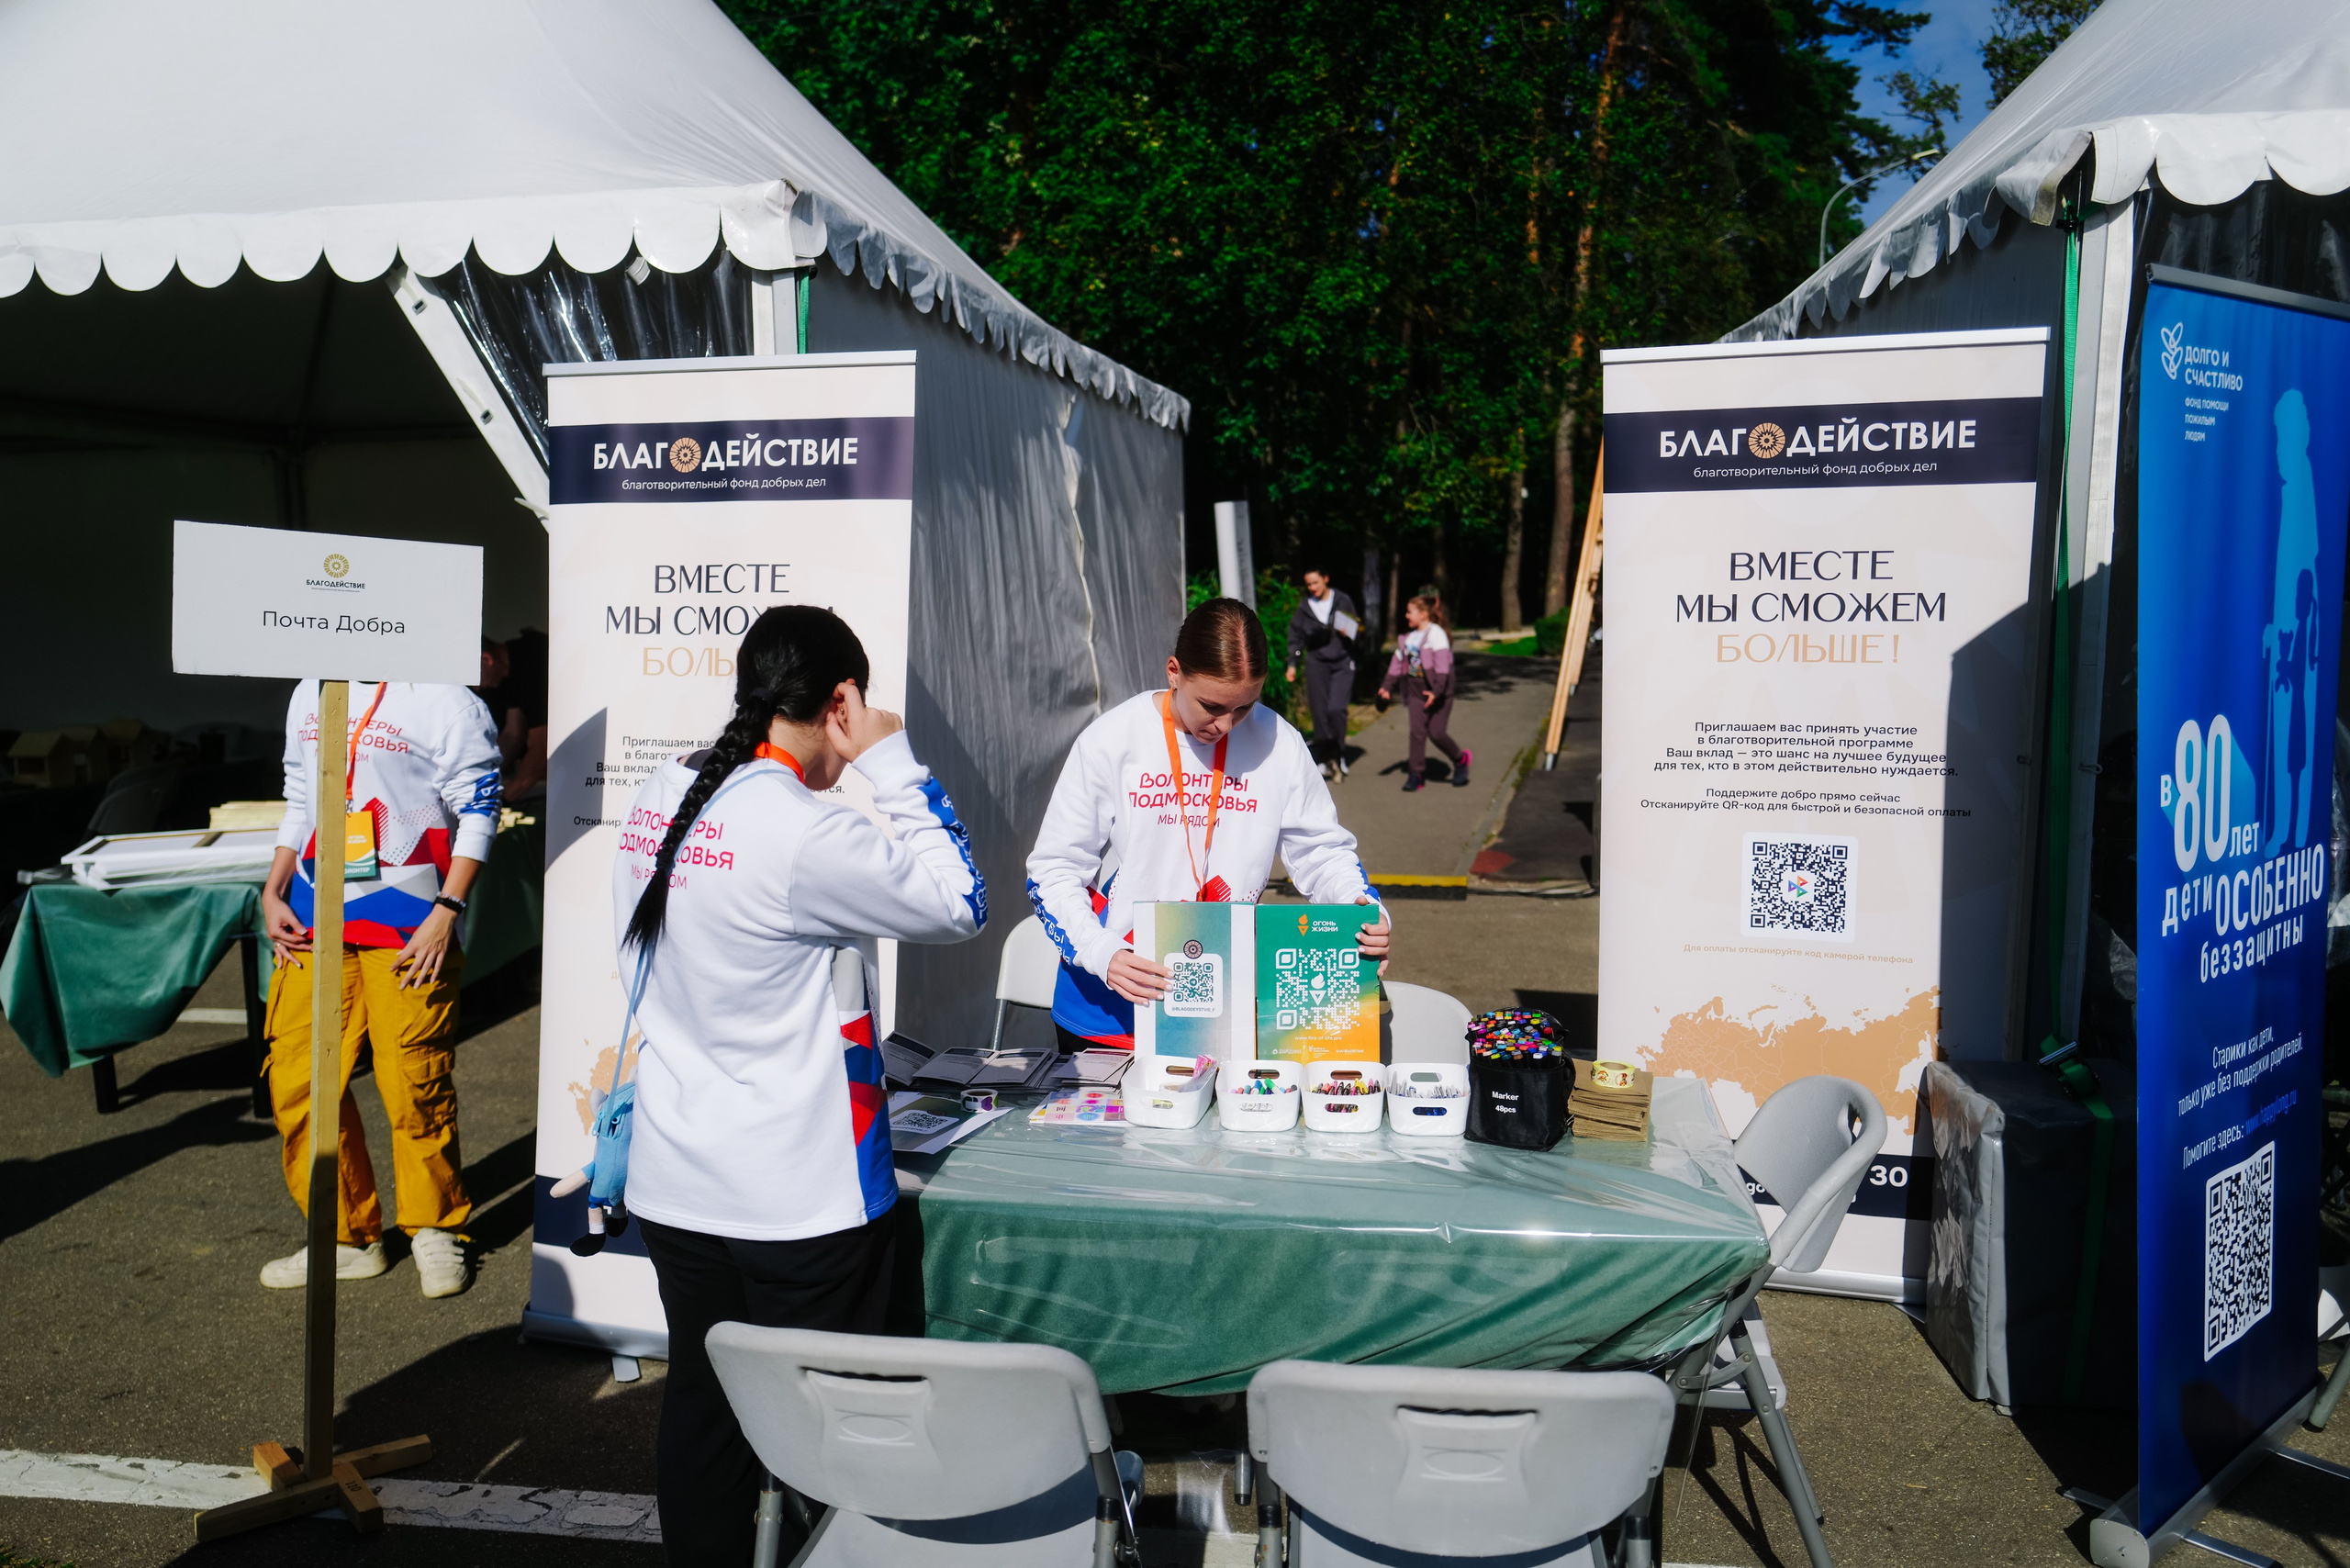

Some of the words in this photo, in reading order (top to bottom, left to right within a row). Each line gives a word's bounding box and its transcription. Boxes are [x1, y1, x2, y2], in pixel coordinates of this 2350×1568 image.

[2185, 346, 2220, 365] ДОЛГО
[2222, 352, 2229, 367] И
[2185, 368, 2243, 391] СЧАСТЛИВО
[1694, 465, 1818, 477] благотворительный
[1823, 465, 1856, 476] фонд
[1860, 462, 1909, 474] добрых
[1913, 464, 1937, 473] дел
[622, 478, 727, 491] благотворительный
[730, 478, 759, 489] фонд
[761, 477, 803, 488] добрых
[805, 478, 826, 488] дел
[1730, 551, 1894, 580] ВМЕСТЕ
[307, 579, 364, 589] БЛАГОДЕЙСТВИЕ
[655, 564, 789, 593] ВМЕСТЕ
[1677, 594, 1737, 622] МЫ
[1752, 593, 1945, 622] СМОЖЕМ
[263, 611, 328, 629] Почта
[336, 616, 404, 635] Добра
[607, 606, 661, 634] МЫ
[643, 646, 741, 677] БОЛЬ
[1695, 722, 1775, 736] Приглашаем
[1779, 724, 1802, 733] вас
[1807, 725, 1859, 737] принять
[1864, 727, 1917, 736] участие
[623, 736, 694, 748] Приглашаем
[697, 740, 717, 749] вас
[1697, 736, 1705, 745] в
[1709, 734, 1834, 746] благотворительной
[1840, 740, 1913, 749] программе
[624, 751, 632, 760] в
[1666, 747, 1693, 757] Ваш
[1696, 749, 1734, 759] вклад
[1751, 749, 1773, 758] это
[1776, 750, 1810, 759] шанс
[1813, 751, 1830, 760] на
[1833, 753, 1882, 762] лучшее
[1887, 752, 1946, 765] будущее
[597, 763, 620, 772] Ваш
[1653, 762, 1677, 772] для
[1680, 762, 1705, 772] тех,
[1707, 762, 1729, 770] кто
[1732, 762, 1740, 770] в
[1743, 762, 1774, 771] этом
[1778, 762, 1876, 774] действительно
[1881, 765, 1959, 778] нуждается.
[586, 778, 605, 787] для
[609, 778, 632, 788] тех,
[1139, 772, 1248, 792] ВОЛОНТРЫ
[1707, 789, 1777, 799] Поддержите
[1781, 790, 1816, 801] добро
[1819, 792, 1856, 802] прямо
[1860, 793, 1900, 802] сейчас
[2174, 713, 2232, 873] 80
[2228, 821, 2259, 857] лет
[1641, 800, 1718, 811] Отсканируйте
[1723, 801, 1764, 811] QR-код
[1766, 802, 1788, 812] для
[1792, 800, 1840, 813] быстрой
[1854, 801, 1923, 815] безопасной
[1927, 808, 1972, 818] оплаты
[574, 816, 623, 827] Отсканир
[1158, 814, 1178, 825] МЫ
[631, 864, 643, 880] МЫ
[2162, 873, 2213, 937] дети
[2215, 843, 2325, 936] ОСОБЕННО
[1683, 944, 1702, 953] Для
[1739, 947, 1802, 957] отсканируйте
[1804, 950, 1822, 959] код
[1823, 952, 1865, 961] камерой
[1866, 955, 1914, 965] телефона
[2199, 914, 2304, 983] беззащитны
[2213, 1042, 2246, 1070] Старики
[2248, 1036, 2258, 1054] как
[2257, 1026, 2273, 1050] дети,
[2178, 1090, 2199, 1116] только
[2201, 1081, 2215, 1108] уже
[2218, 1072, 2231, 1093] без
[2232, 1054, 2269, 1087] поддержки
[2269, 1031, 2302, 1071] родителей.
[1493, 1092, 1518, 1100] Marker
[1495, 1105, 1516, 1114] 48pcs
[2184, 1135, 2216, 1169] Помогите
[2218, 1126, 2244, 1150] здесь:
[1870, 1165, 1908, 1187] 30
